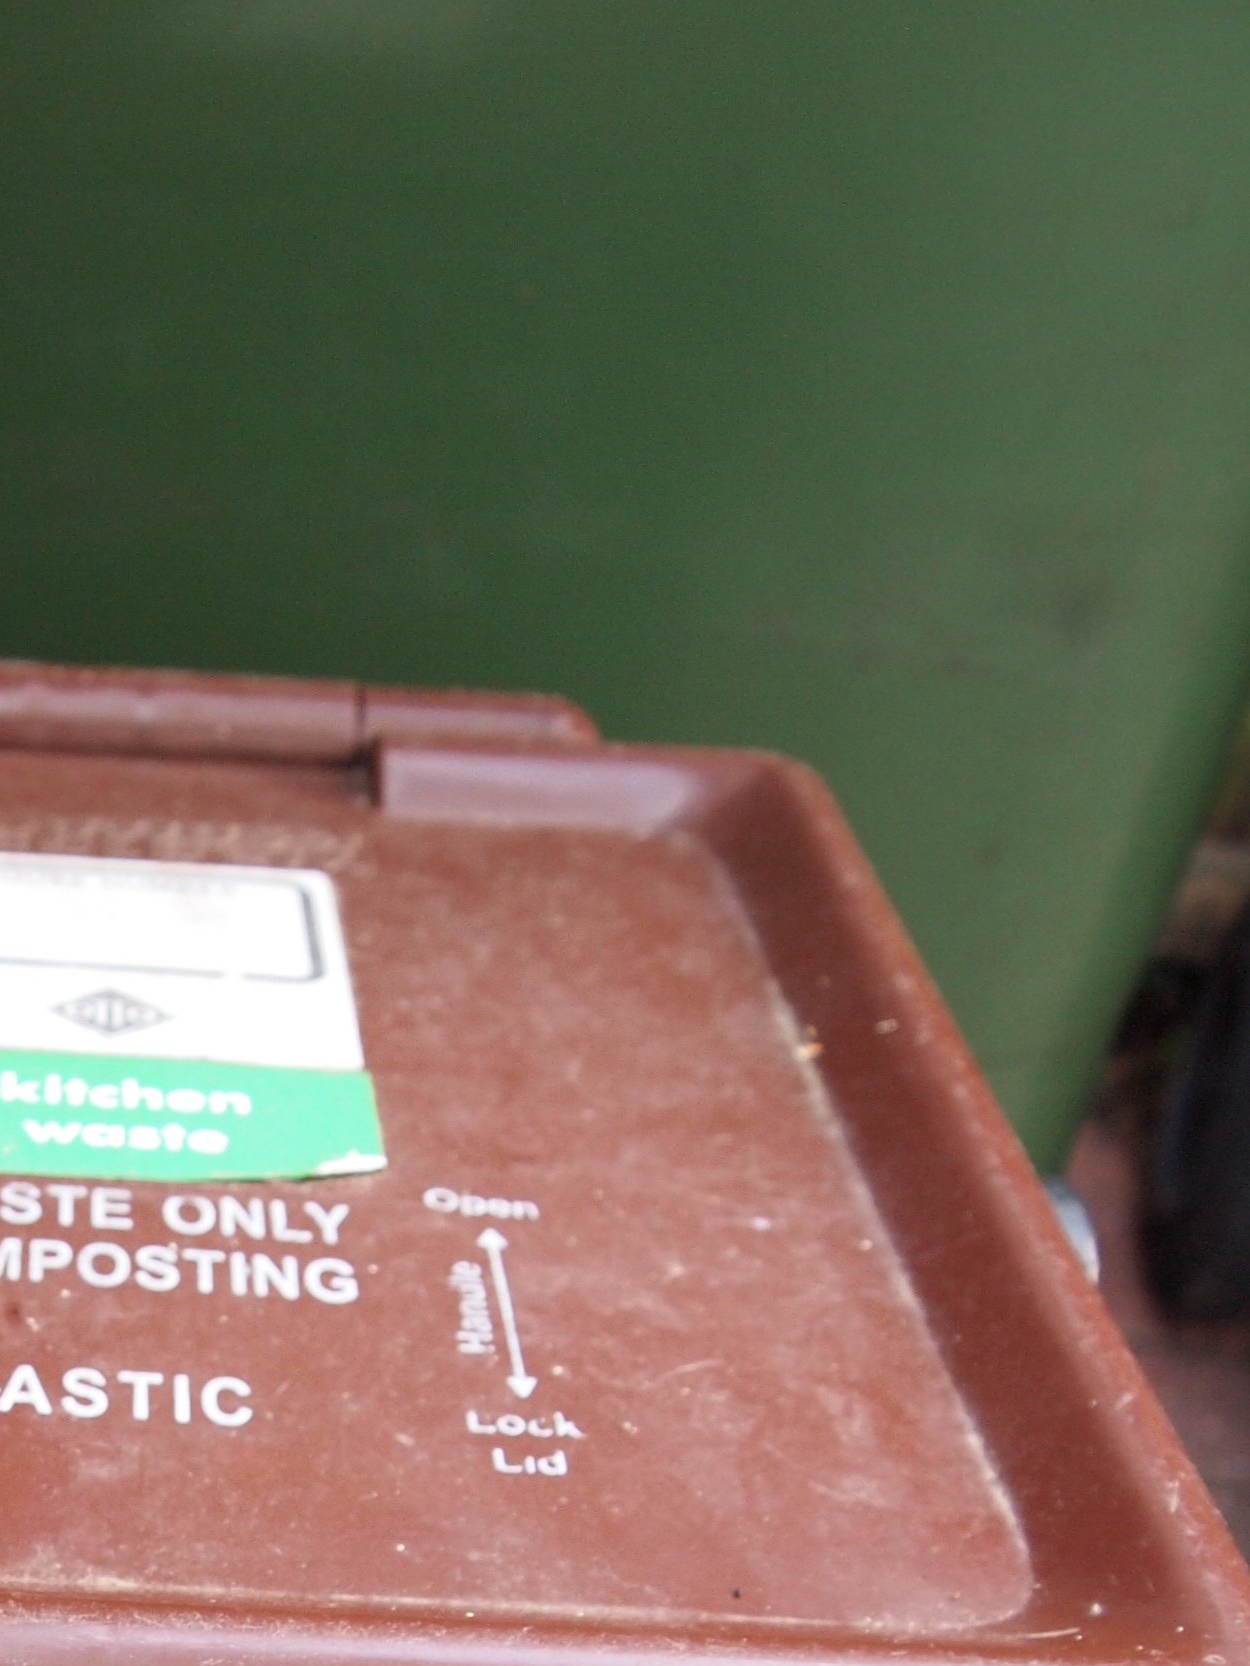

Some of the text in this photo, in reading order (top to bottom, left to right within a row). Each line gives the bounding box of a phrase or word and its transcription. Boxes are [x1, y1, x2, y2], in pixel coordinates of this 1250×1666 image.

[0, 1070, 252, 1116] kitchen
[22, 1119, 229, 1155] waste
[162, 1194, 351, 1246] ONLY
[422, 1187, 541, 1221] Open
[465, 1409, 586, 1439] Lock
[491, 1447, 568, 1476] Lid
